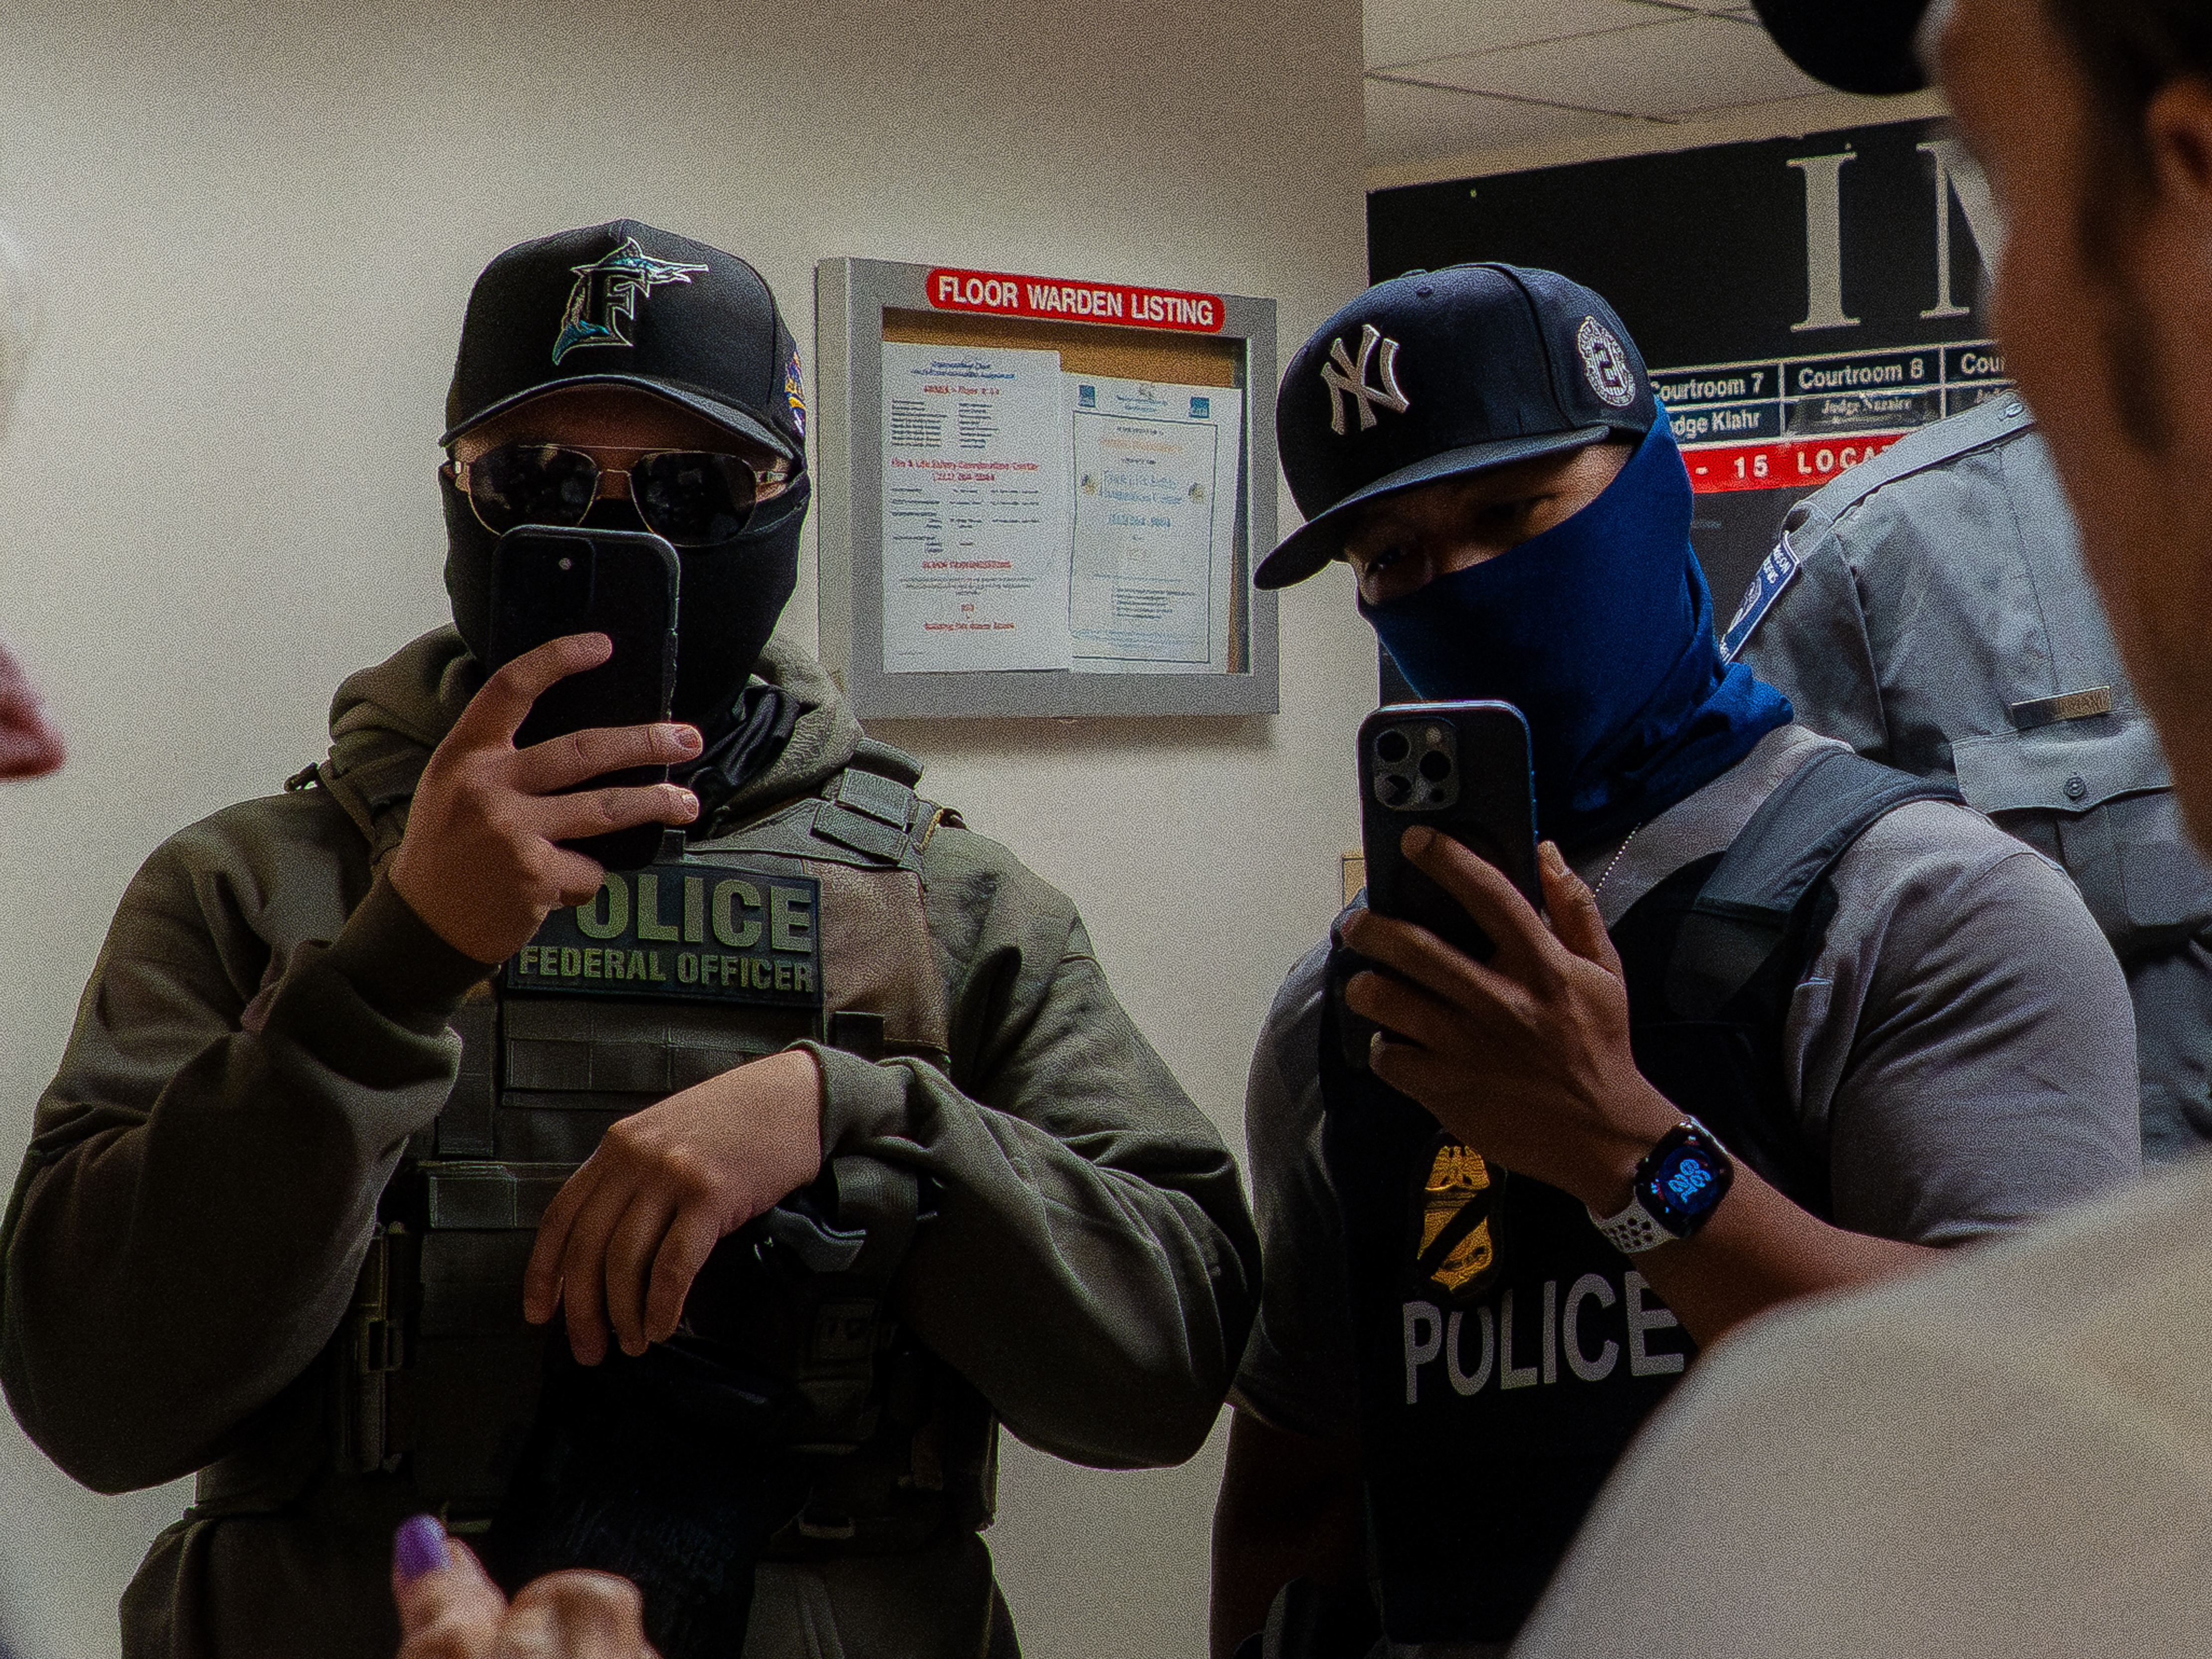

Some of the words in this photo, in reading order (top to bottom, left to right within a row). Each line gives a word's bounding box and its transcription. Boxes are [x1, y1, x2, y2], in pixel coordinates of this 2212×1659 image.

[937, 275, 1019, 311] FLOOR
[1027, 283, 1123, 319] WARDEN
[1131, 293, 1214, 326] LISTING
[1751, 372, 1764, 395] 7
[1798, 363, 1902, 389] Courtroom
[1910, 357, 1924, 379] 8
[1712, 410, 1761, 432] Klahr
[1734, 454, 1769, 479] 15
[576, 871, 813, 953] OLICE
[519, 946, 666, 982] FEDERAL
[677, 953, 815, 993] OFFICER
[1403, 1271, 1685, 1405] POLICE
